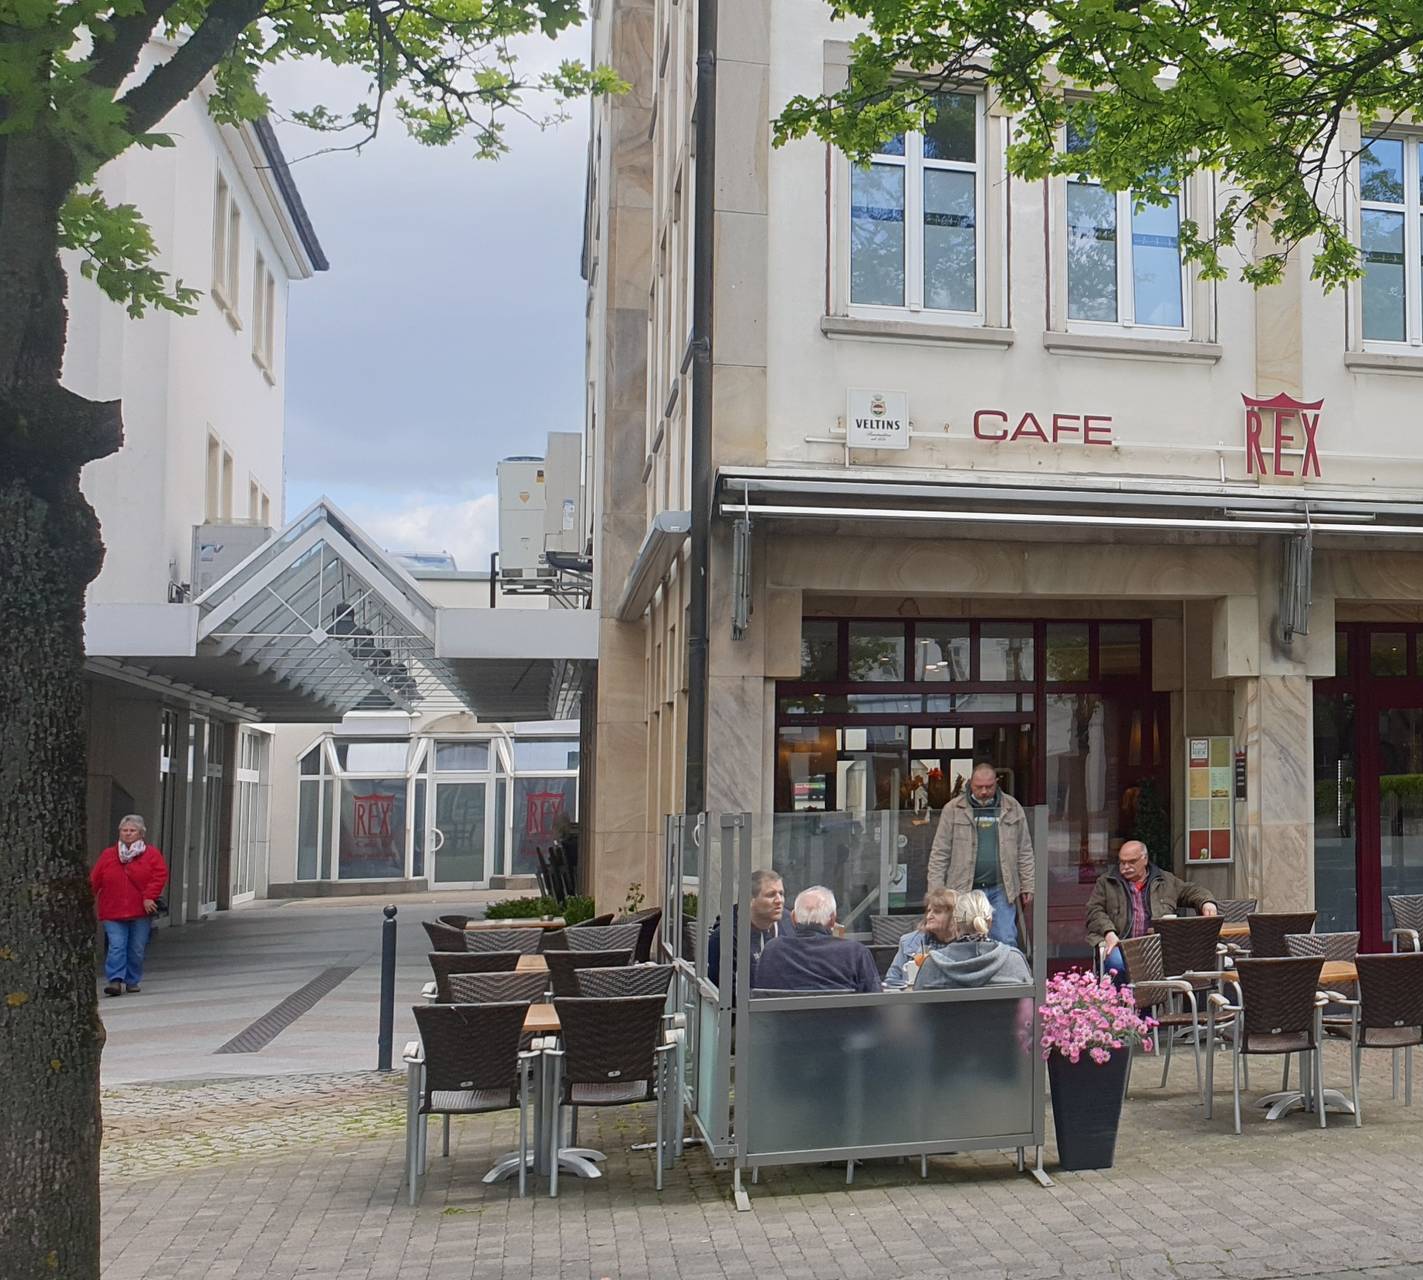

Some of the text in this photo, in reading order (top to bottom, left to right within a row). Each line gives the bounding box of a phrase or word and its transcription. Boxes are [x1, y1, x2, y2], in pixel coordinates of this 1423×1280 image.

[855, 418, 901, 431] VELTINS
[973, 409, 1113, 445] CAFE
[1246, 405, 1321, 477] REX
[356, 801, 391, 835] REX
